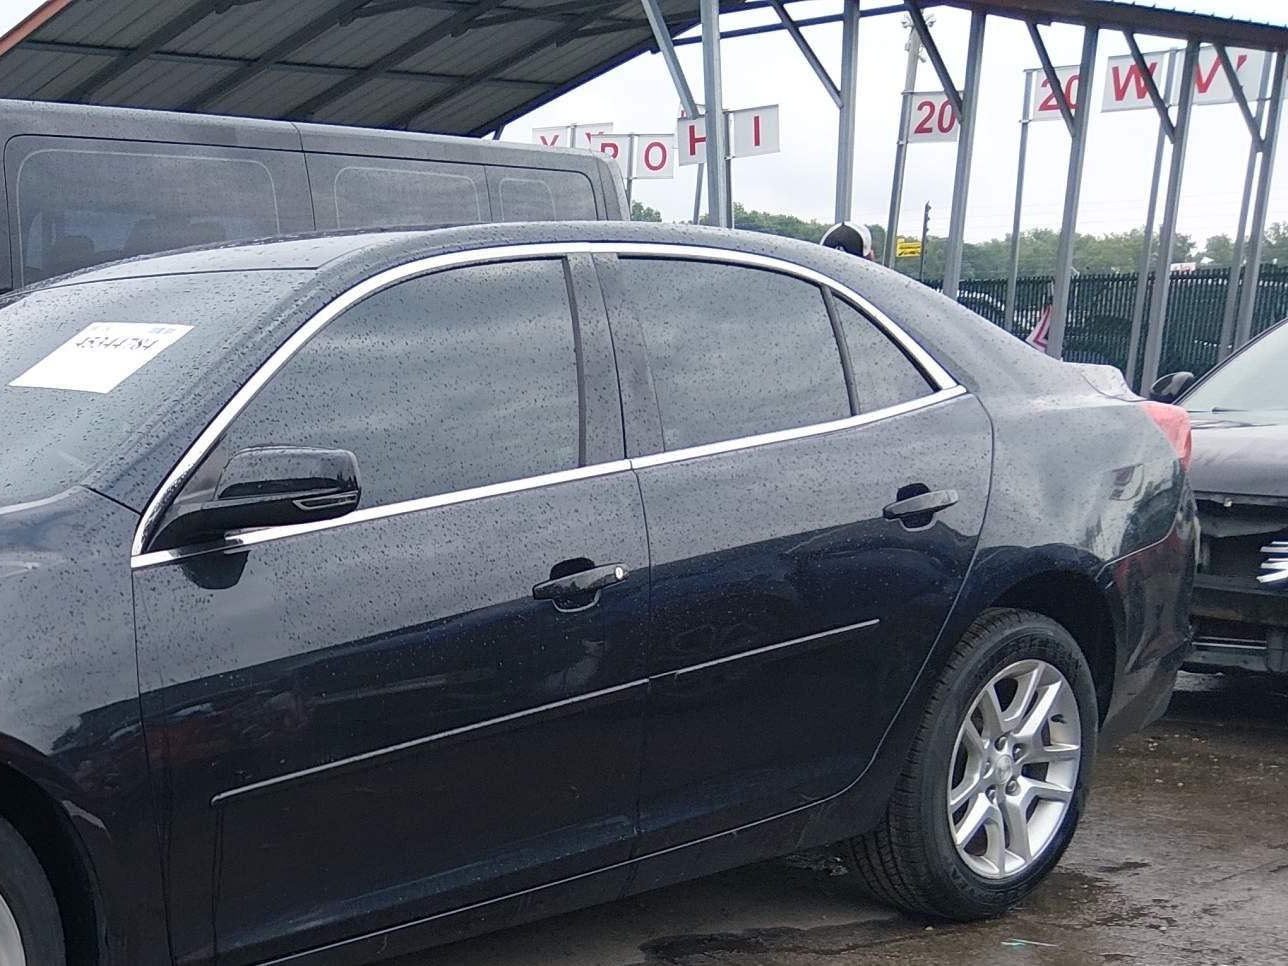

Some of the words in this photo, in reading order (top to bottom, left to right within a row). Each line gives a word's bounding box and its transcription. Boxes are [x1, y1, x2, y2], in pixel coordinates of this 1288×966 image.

[1112, 62, 1158, 101] W
[914, 98, 958, 134] 20
[644, 141, 668, 171] O
